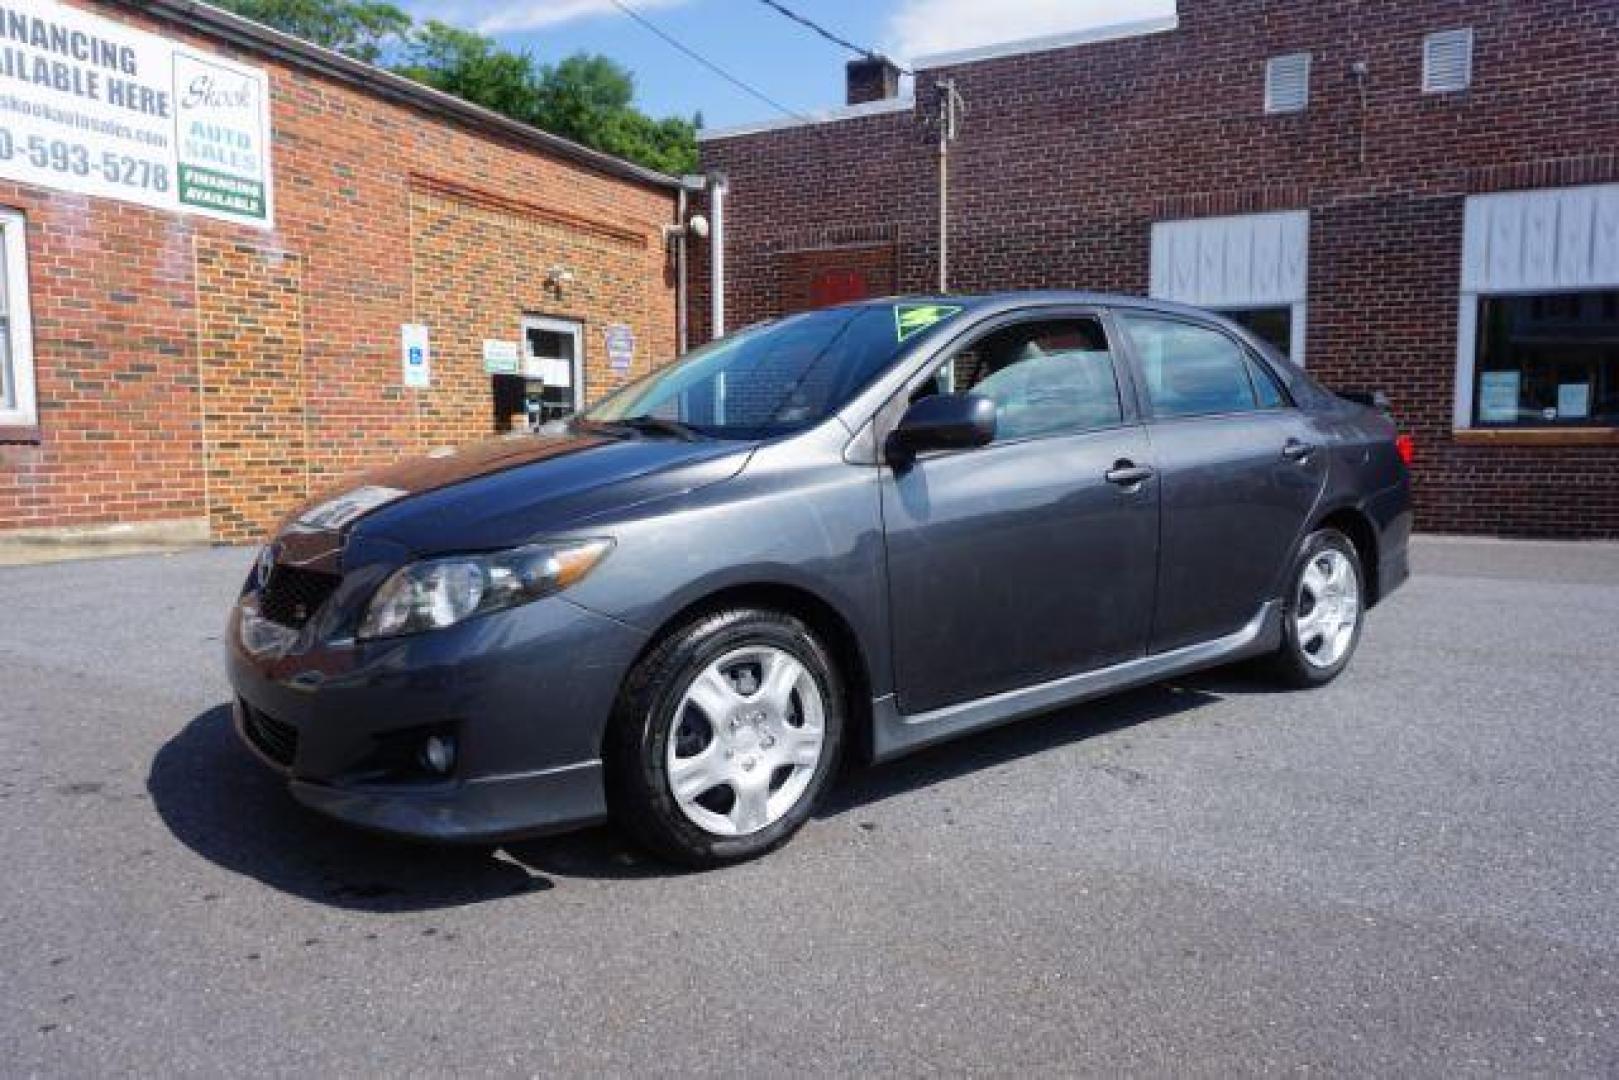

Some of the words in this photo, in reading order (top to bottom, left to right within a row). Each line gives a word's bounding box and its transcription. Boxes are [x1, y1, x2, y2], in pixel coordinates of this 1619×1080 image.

[0, 48, 100, 100] ILABLE
[107, 78, 170, 119] HERE
[190, 121, 252, 150] AUTO
[184, 138, 257, 173] SALES
